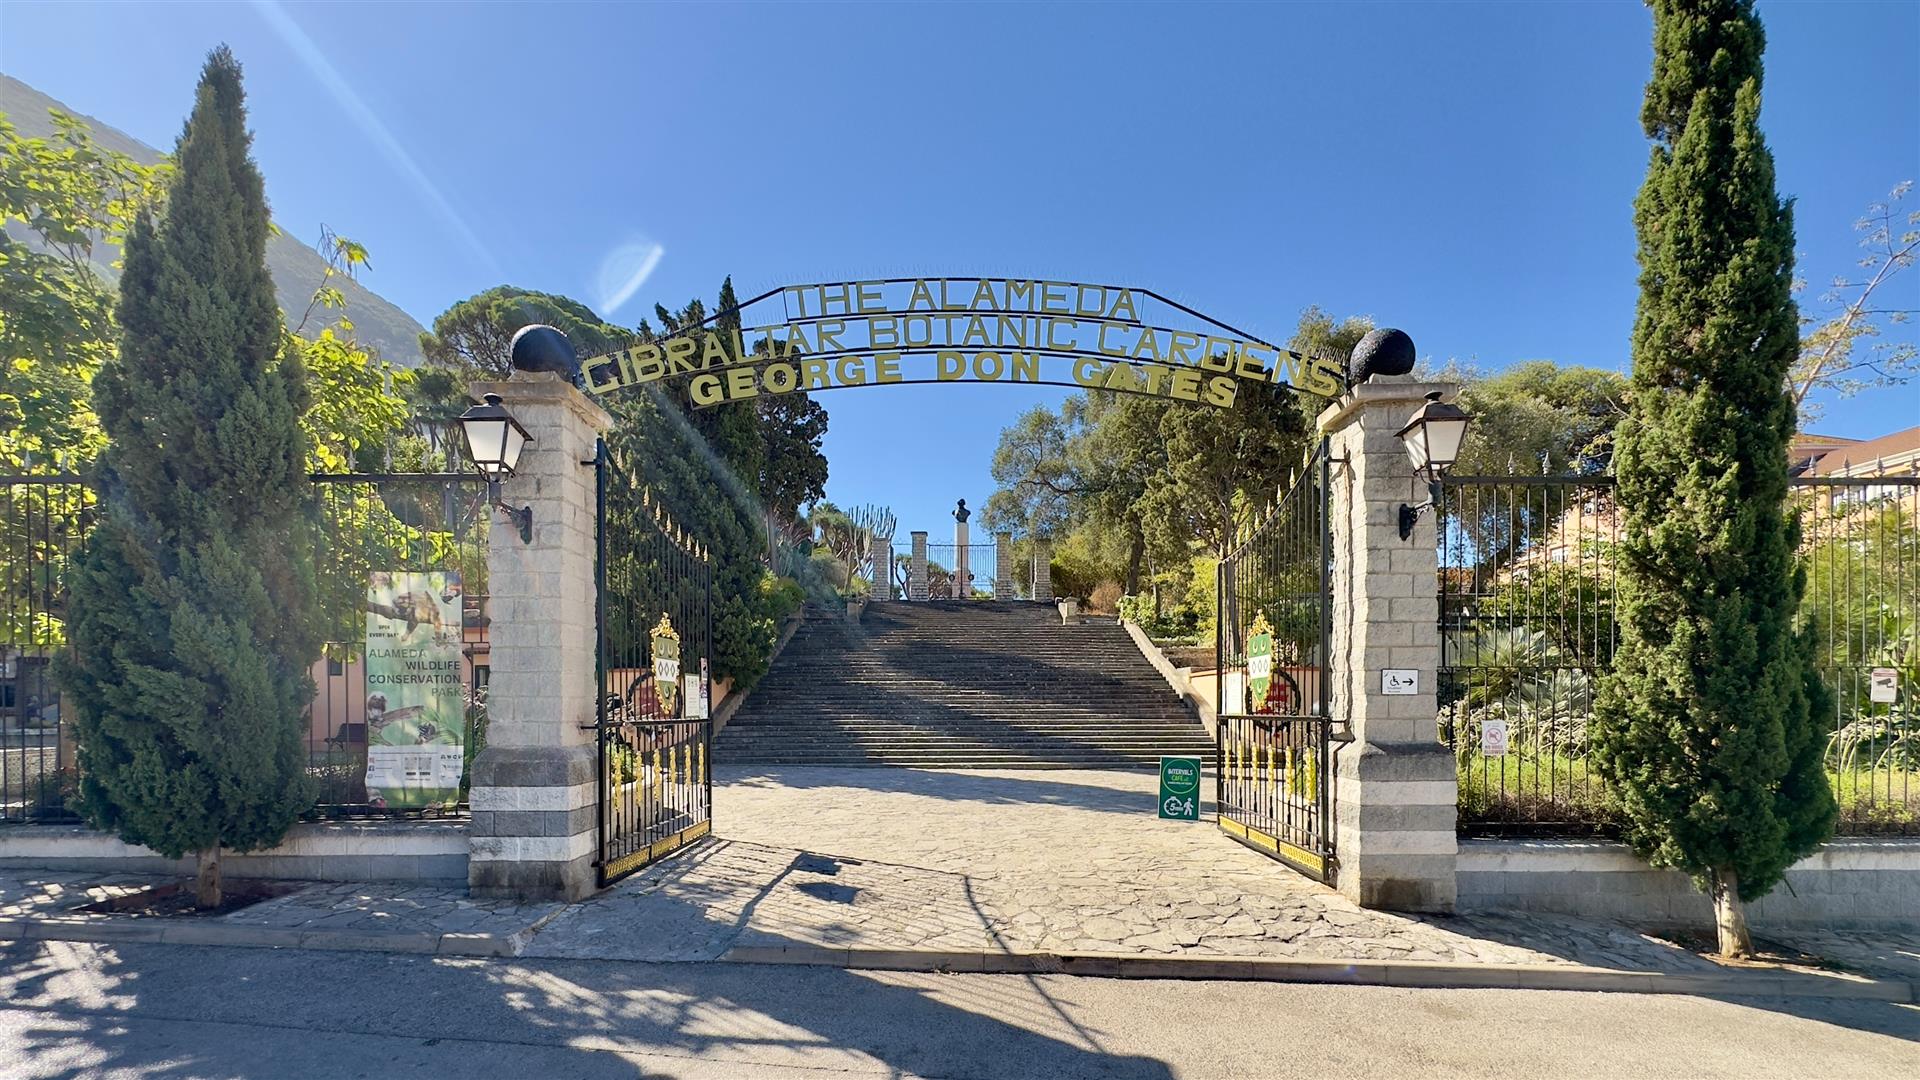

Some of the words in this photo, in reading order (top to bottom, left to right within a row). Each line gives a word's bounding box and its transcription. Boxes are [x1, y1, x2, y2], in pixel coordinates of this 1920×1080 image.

[785, 280, 887, 318] THE
[908, 278, 1138, 320] ALAMEDA
[581, 318, 848, 395] GIBRALTAR
[868, 314, 1078, 350] BOTANIC
[1097, 321, 1342, 397] GARDENS
[689, 352, 903, 405] GEORGE
[936, 351, 1040, 381] DON
[1072, 356, 1238, 409] GATES
[369, 649, 427, 658] ALAMEDA
[406, 661, 460, 670] WILDLIFE
[369, 675, 460, 684] CONSERVATION
[432, 688, 460, 697] PARK
